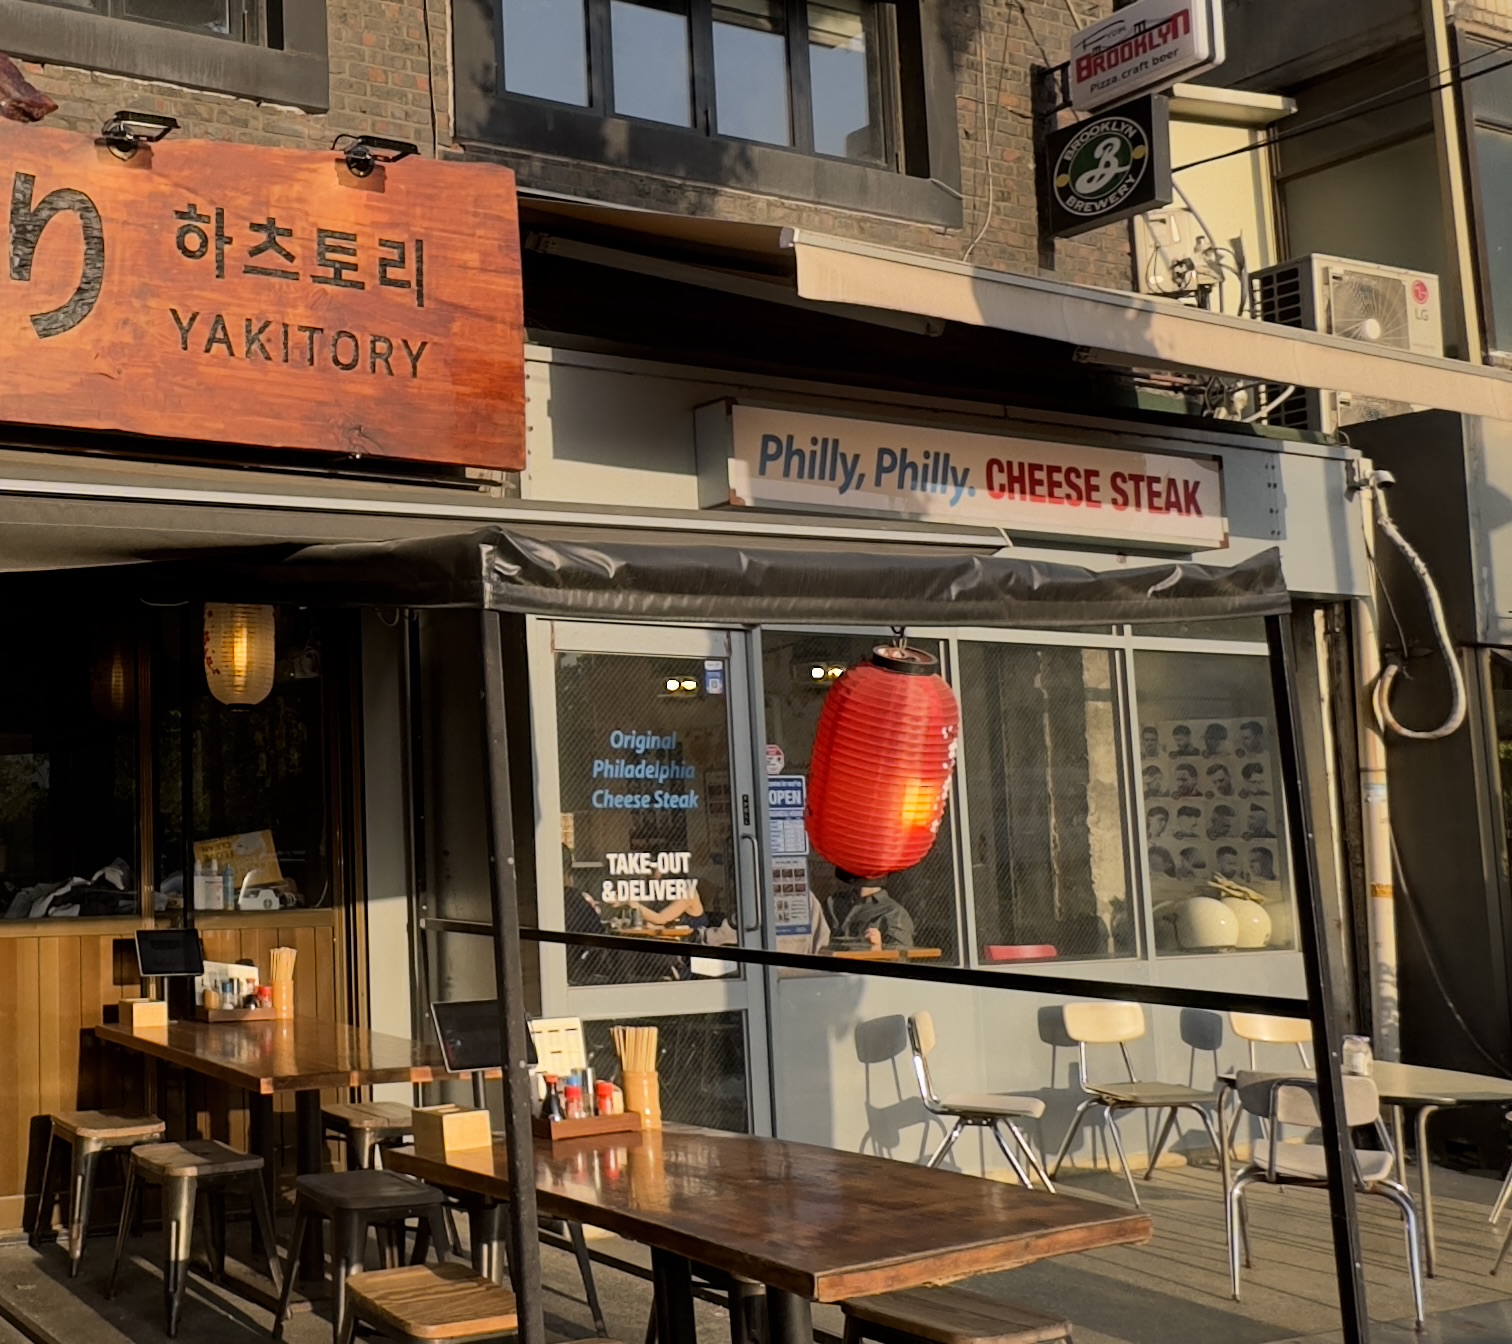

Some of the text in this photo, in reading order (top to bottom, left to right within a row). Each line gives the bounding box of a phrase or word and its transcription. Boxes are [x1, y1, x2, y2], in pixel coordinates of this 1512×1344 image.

[1152, 48, 1179, 66] beer
[1063, 120, 1137, 161] BROOKLYN
[1065, 173, 1136, 212] BREWERY
[174, 203, 425, 308] 하츠토리
[169, 308, 429, 379] YAKITORY
[986, 457, 1102, 508] CHEESE
[1110, 470, 1204, 518] STEAK
[610, 730, 677, 754] Original
[592, 759, 696, 784] Philadelphia
[592, 789, 699, 809] Cheese Steak
[768, 790, 802, 805] OPEN
[606, 852, 691, 875] TAKE-OUT
